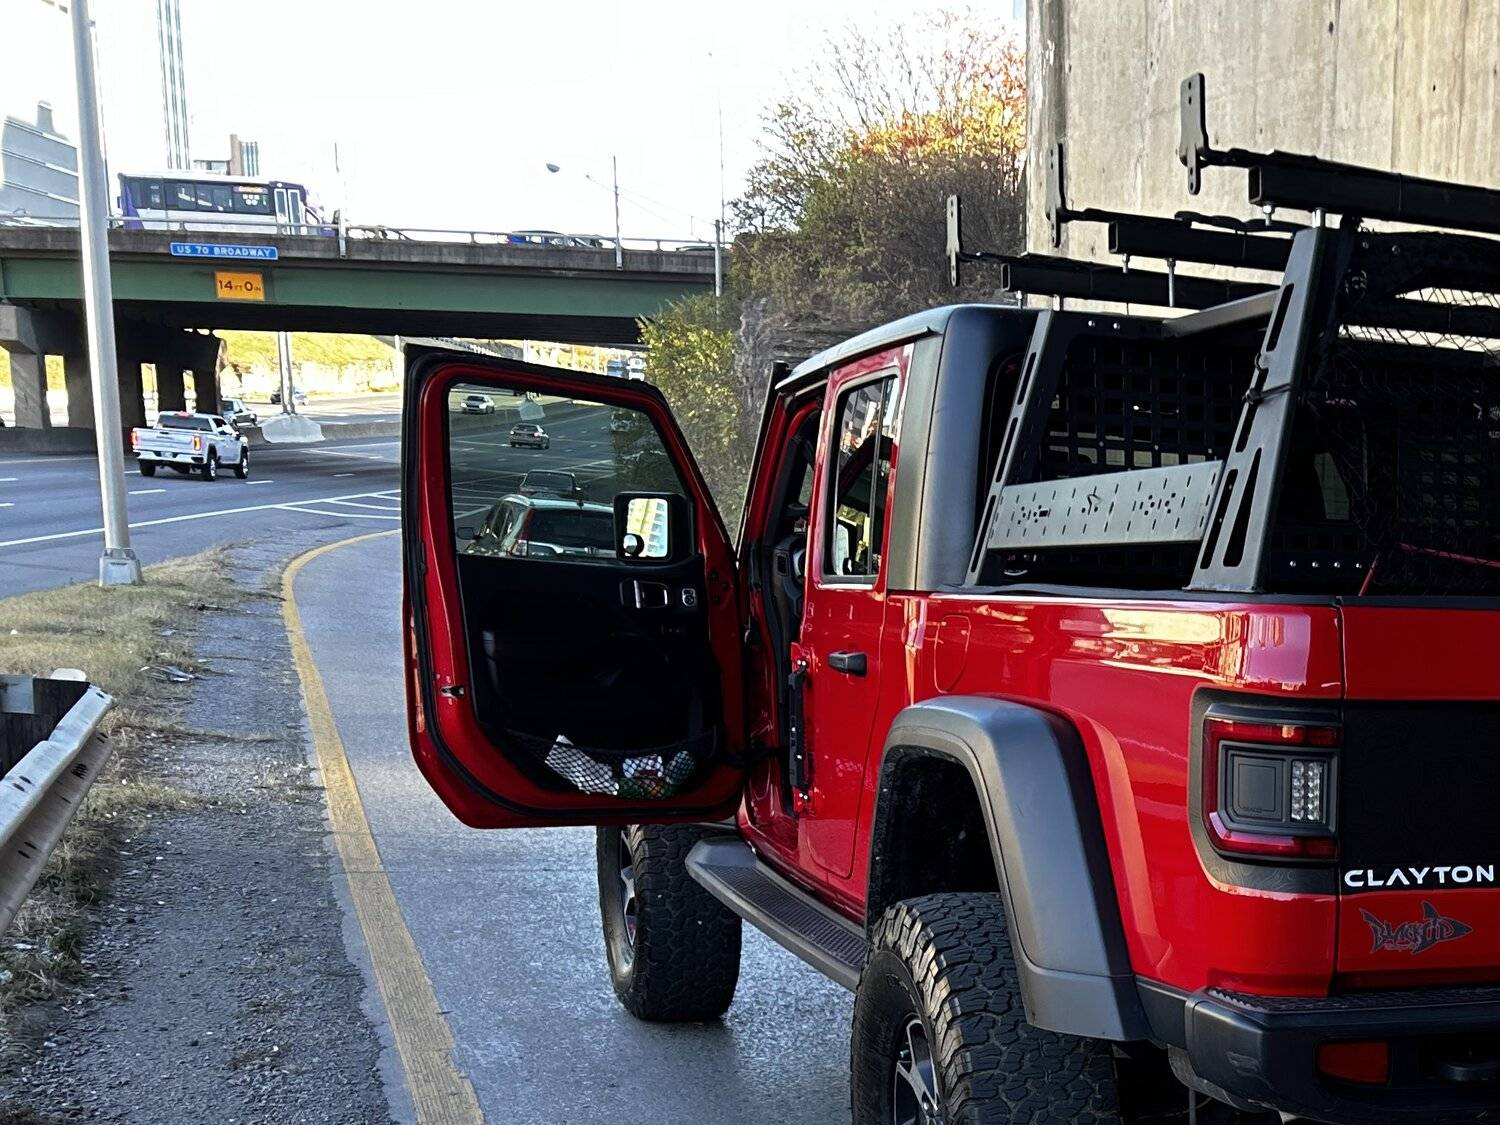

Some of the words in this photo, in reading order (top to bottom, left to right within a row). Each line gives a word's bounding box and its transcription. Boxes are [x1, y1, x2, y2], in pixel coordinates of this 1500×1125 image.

[176, 245, 191, 254] US
[195, 246, 209, 254] 70
[213, 246, 271, 257] BROADWAY
[218, 279, 233, 290] 14
[244, 281, 254, 292] 0
[1344, 864, 1495, 888] CLAYTON
